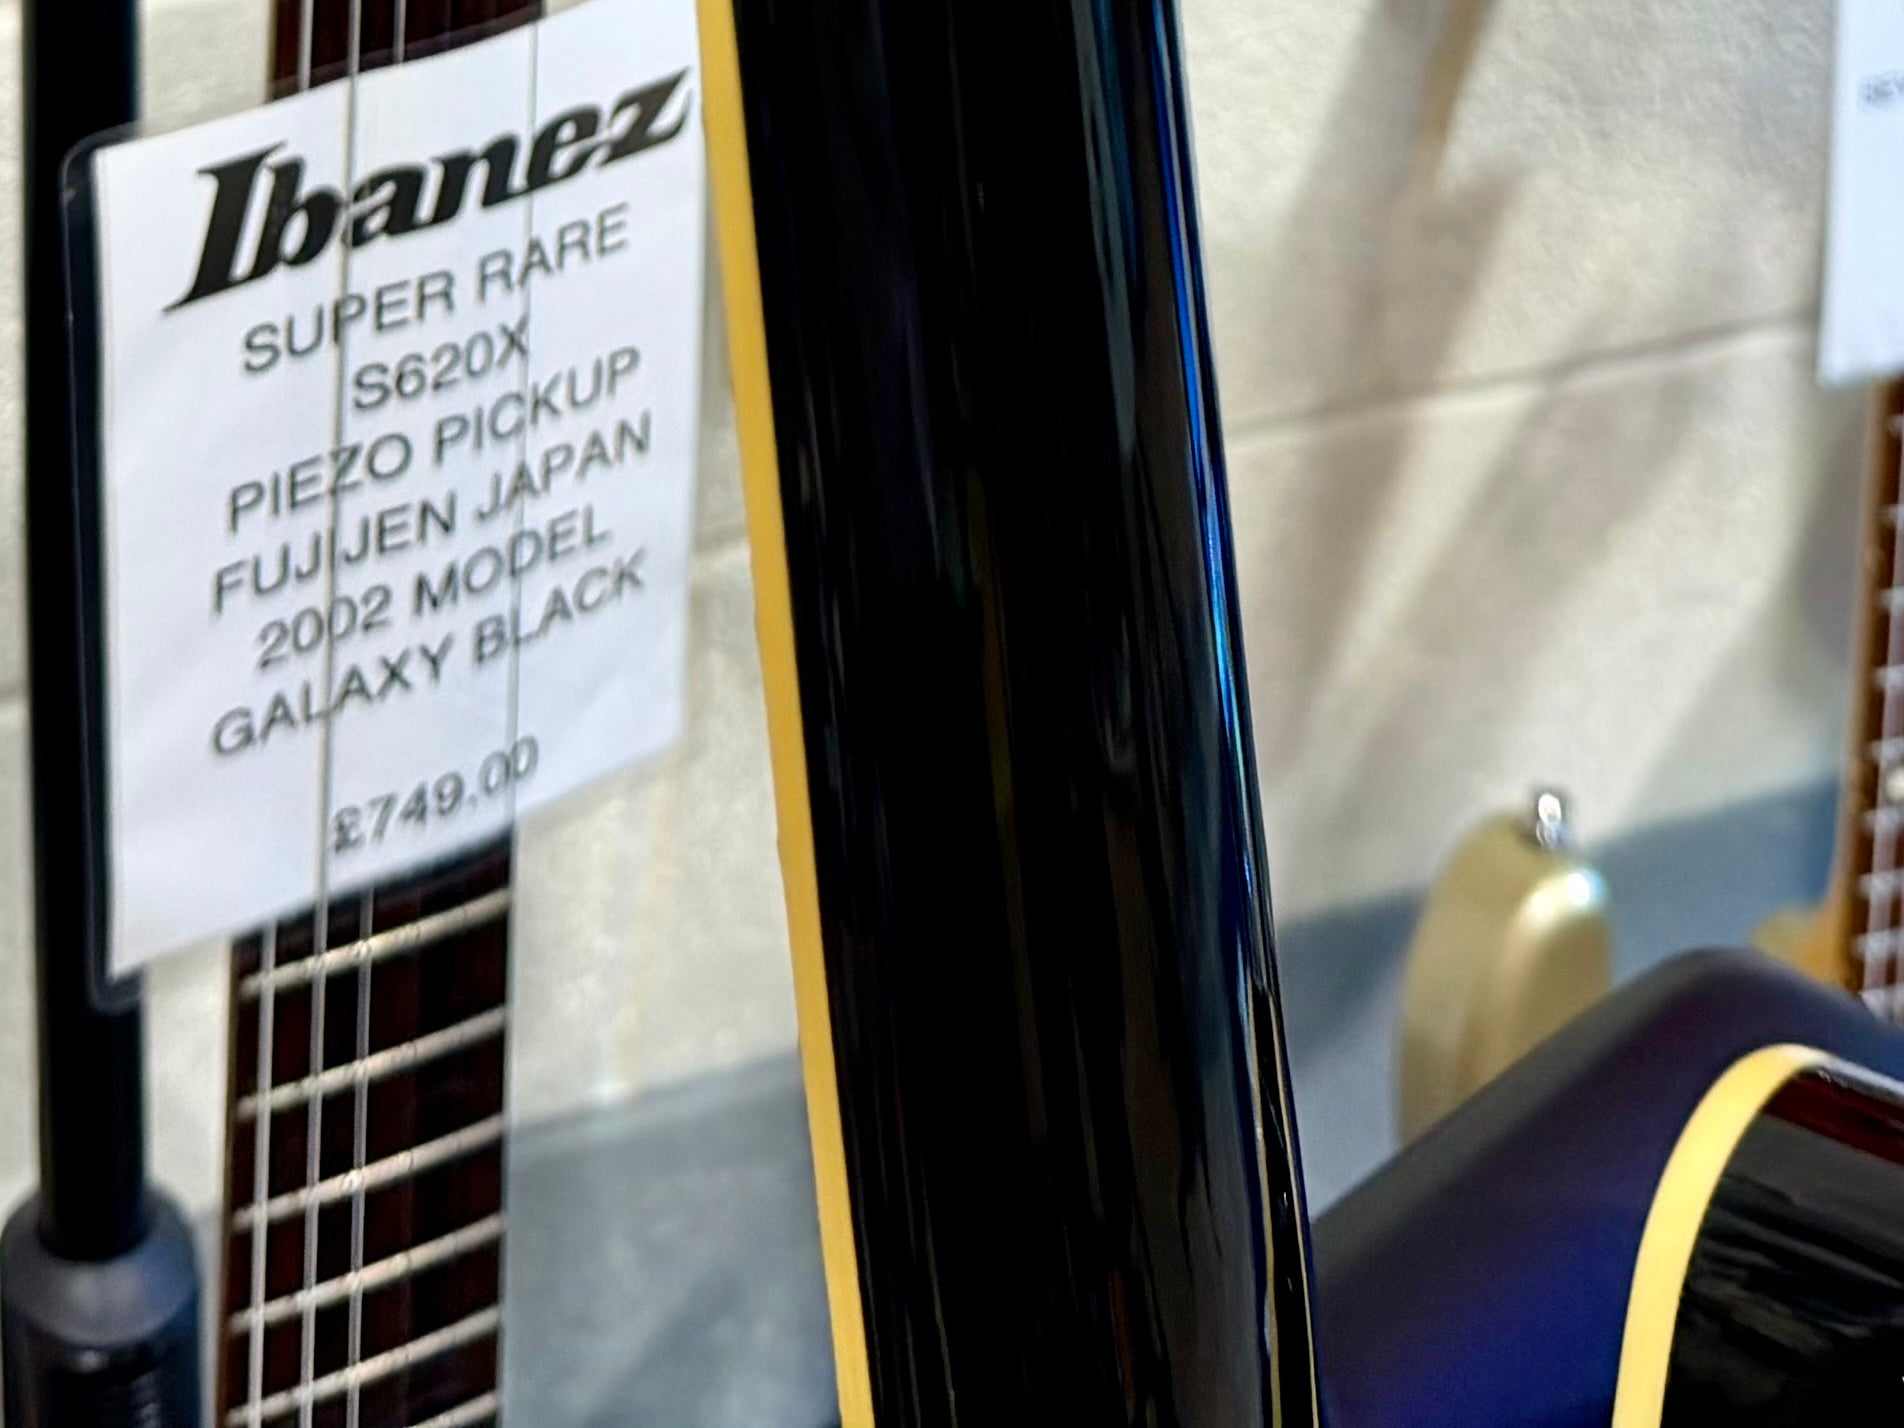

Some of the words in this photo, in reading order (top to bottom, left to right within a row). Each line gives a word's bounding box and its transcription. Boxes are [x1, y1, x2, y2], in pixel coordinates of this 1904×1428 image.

[162, 67, 693, 314] Ibanez
[241, 268, 456, 376] SUPER
[476, 202, 632, 296] RARE
[351, 312, 531, 413] S620X
[227, 430, 413, 534] PIEZO
[432, 345, 643, 459] PICKUP
[474, 408, 653, 524] JAPAN
[209, 632, 454, 761] GALAXY
[472, 548, 650, 664] BLACK
[254, 584, 392, 672] 2002
[411, 502, 613, 617] MODEL
[326, 731, 540, 857] £749.00
